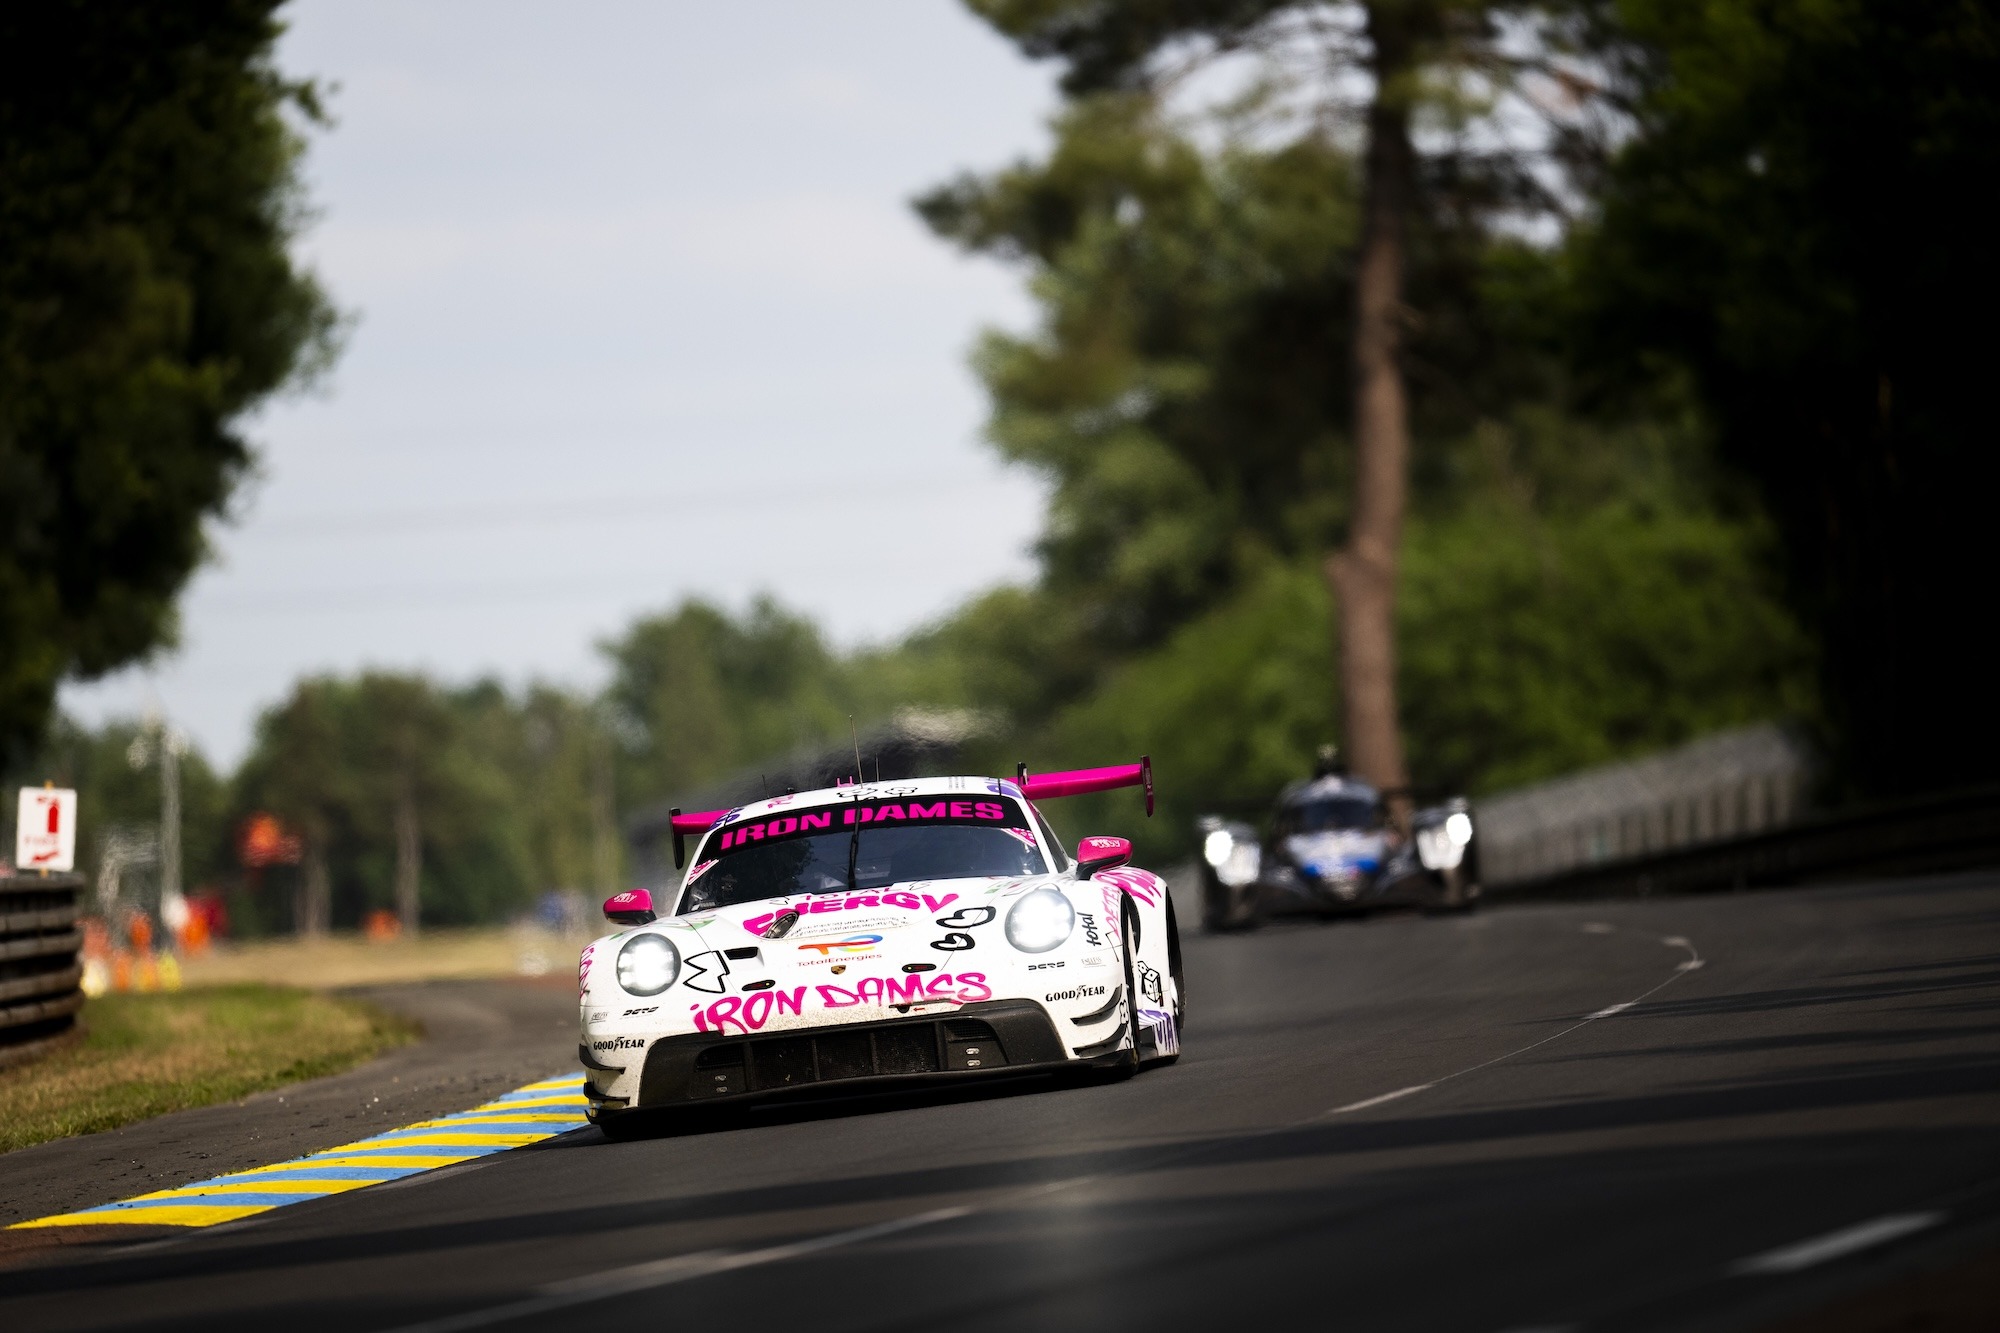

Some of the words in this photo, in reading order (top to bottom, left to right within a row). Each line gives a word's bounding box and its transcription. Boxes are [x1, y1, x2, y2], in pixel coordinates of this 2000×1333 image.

[720, 811, 831, 850] IRON
[843, 801, 1004, 825] DAMES
[798, 953, 882, 967] TotalEnergies
[1045, 985, 1105, 1002] GOODYEAR
[593, 1036, 645, 1052] GOODYEAR
